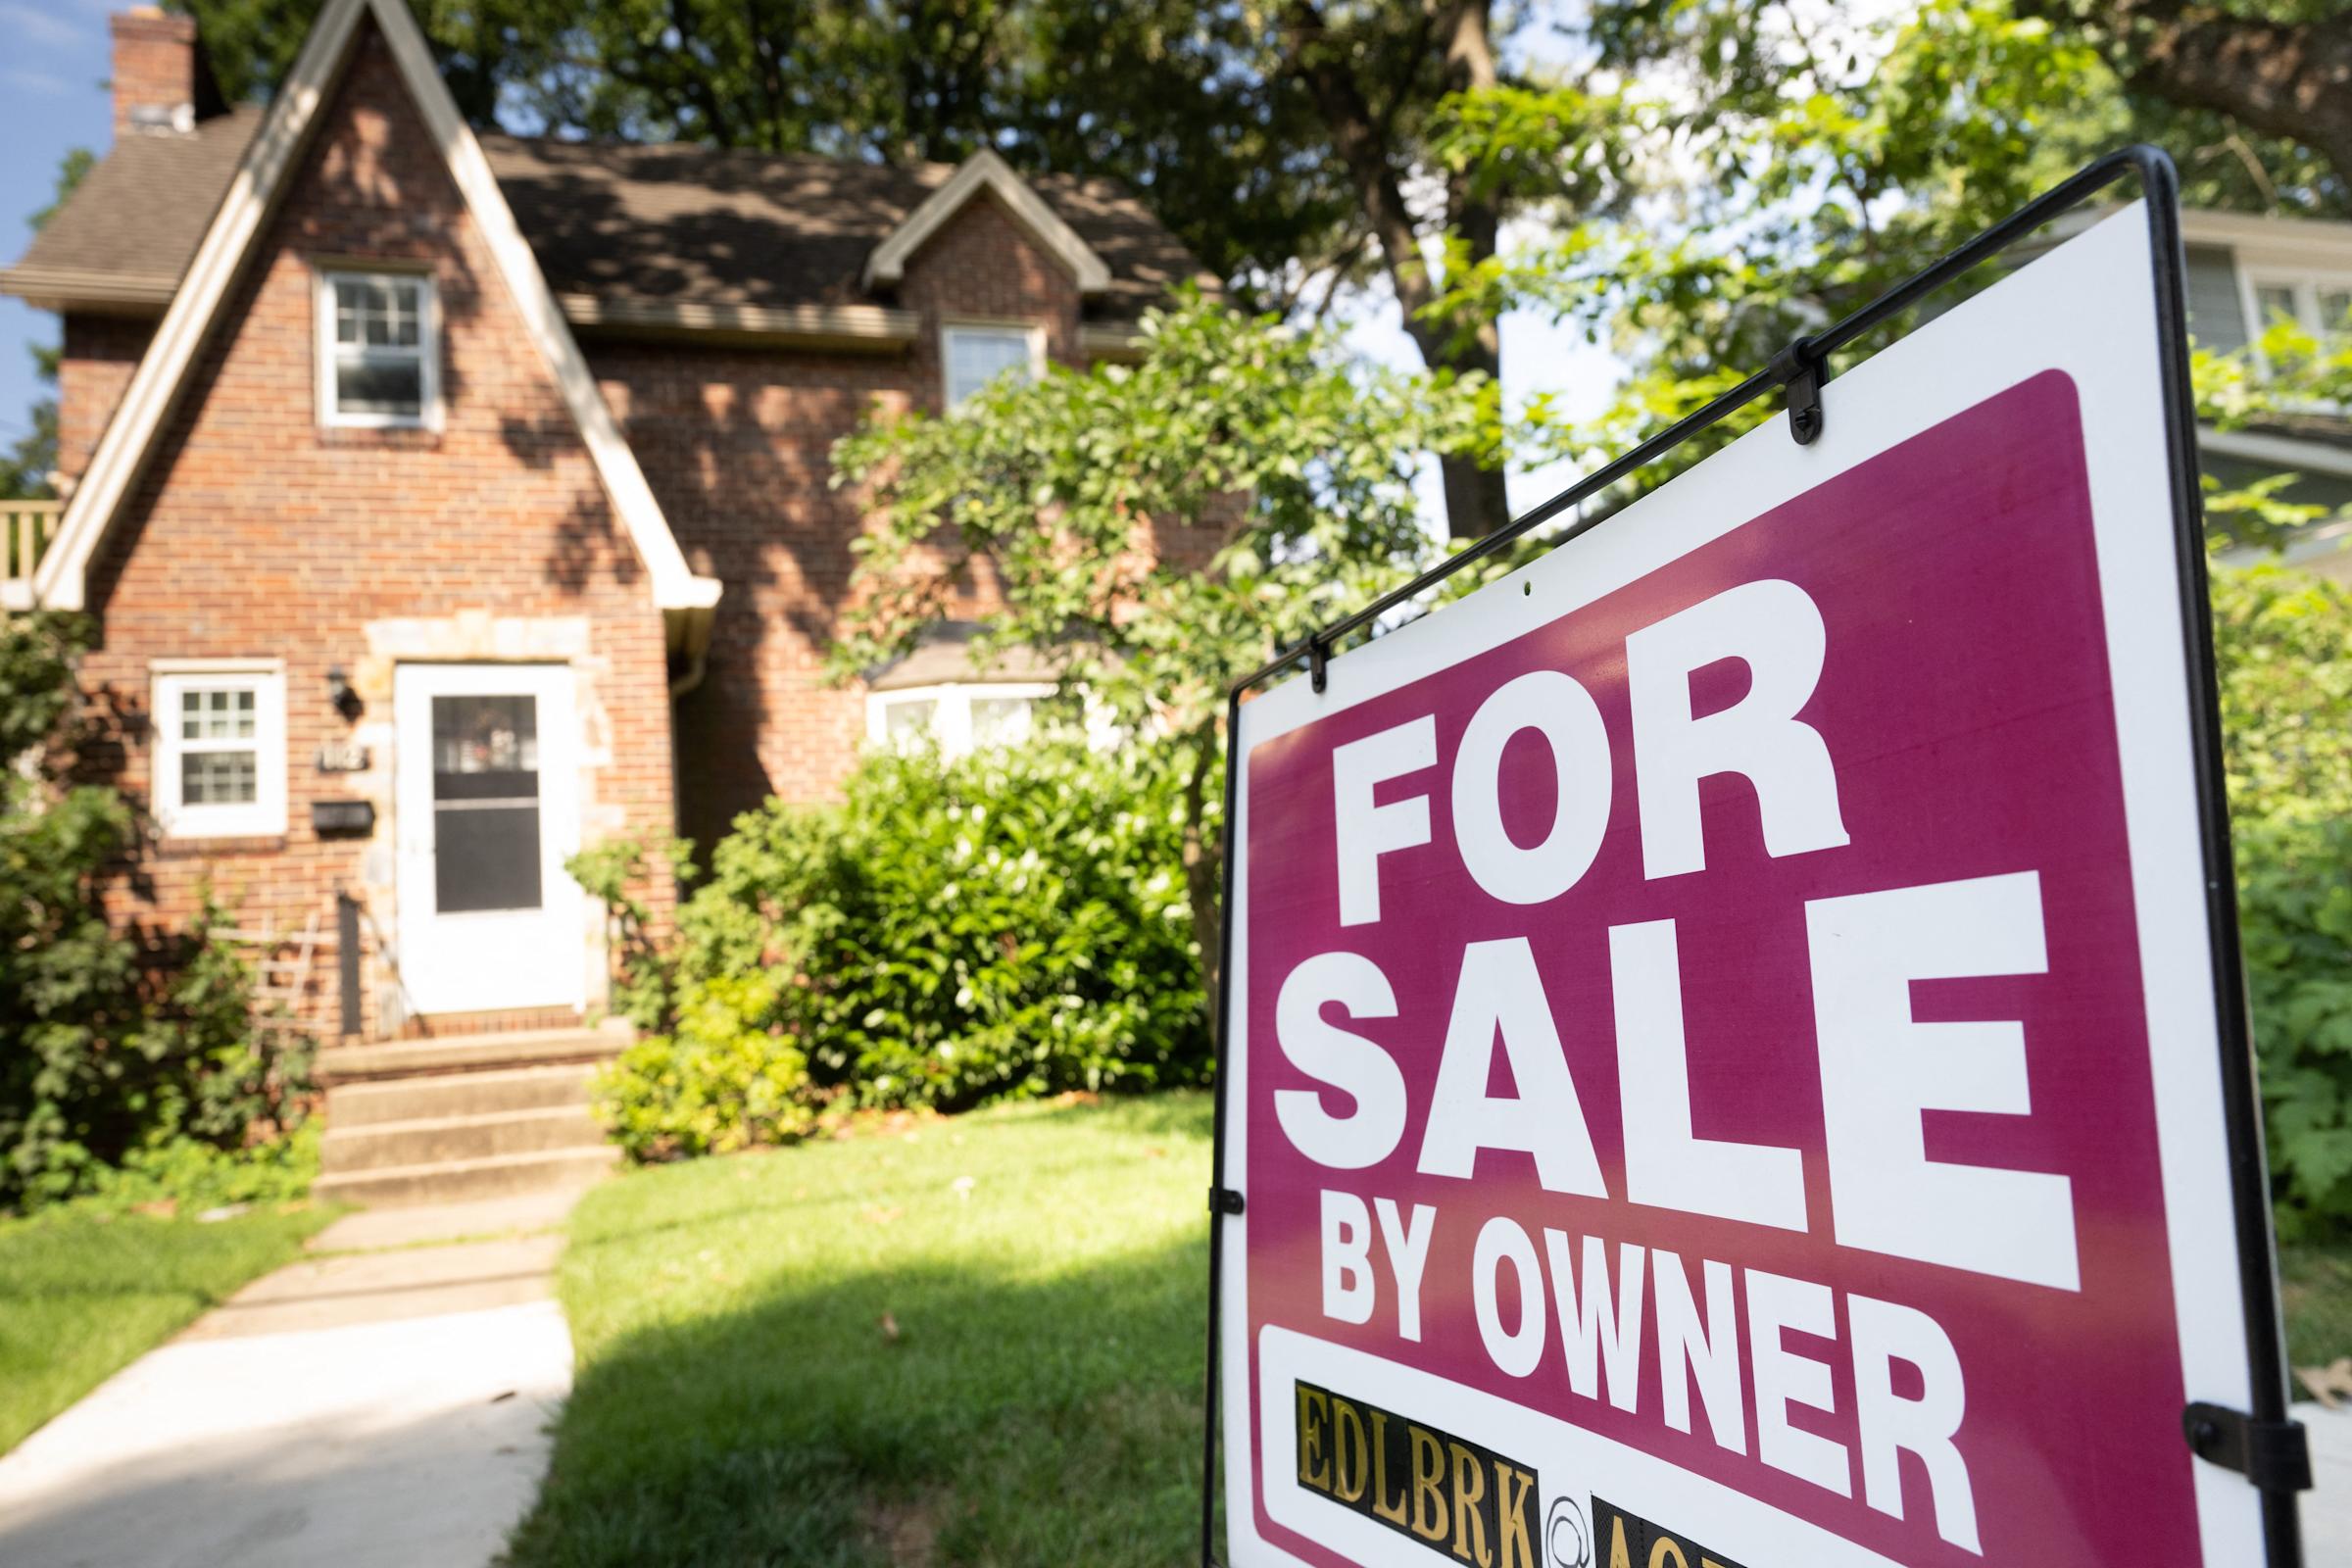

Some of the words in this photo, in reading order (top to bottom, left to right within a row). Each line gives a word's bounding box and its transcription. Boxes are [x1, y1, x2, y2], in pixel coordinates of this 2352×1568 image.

[1333, 579, 1850, 926] FOR
[1275, 871, 2081, 1292] SALE
[1321, 1190, 1437, 1342] BY
[1473, 1216, 1983, 1555] OWNER
